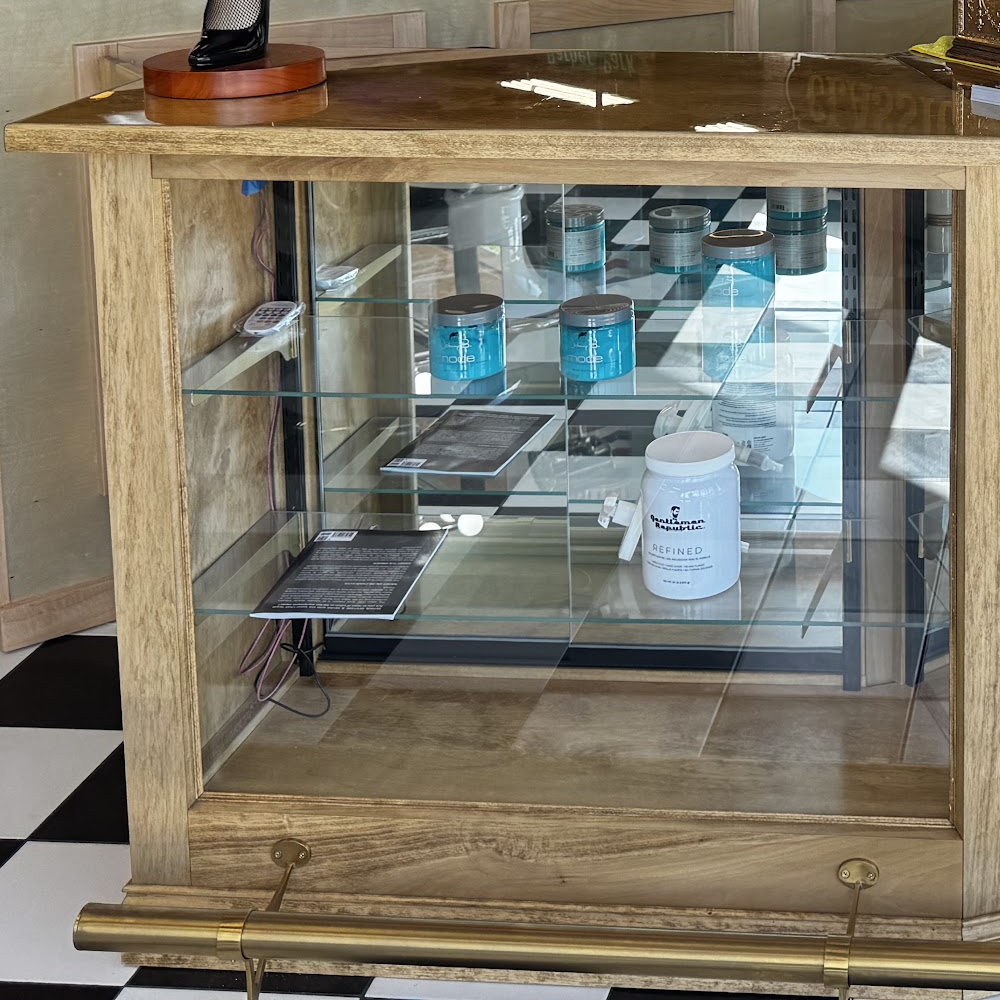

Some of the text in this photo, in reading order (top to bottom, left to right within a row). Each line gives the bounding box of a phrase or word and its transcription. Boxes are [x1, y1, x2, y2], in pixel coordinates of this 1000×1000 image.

[650, 514, 706, 525] Gentleman
[655, 521, 704, 532] Republic
[652, 543, 703, 556] REFINED
